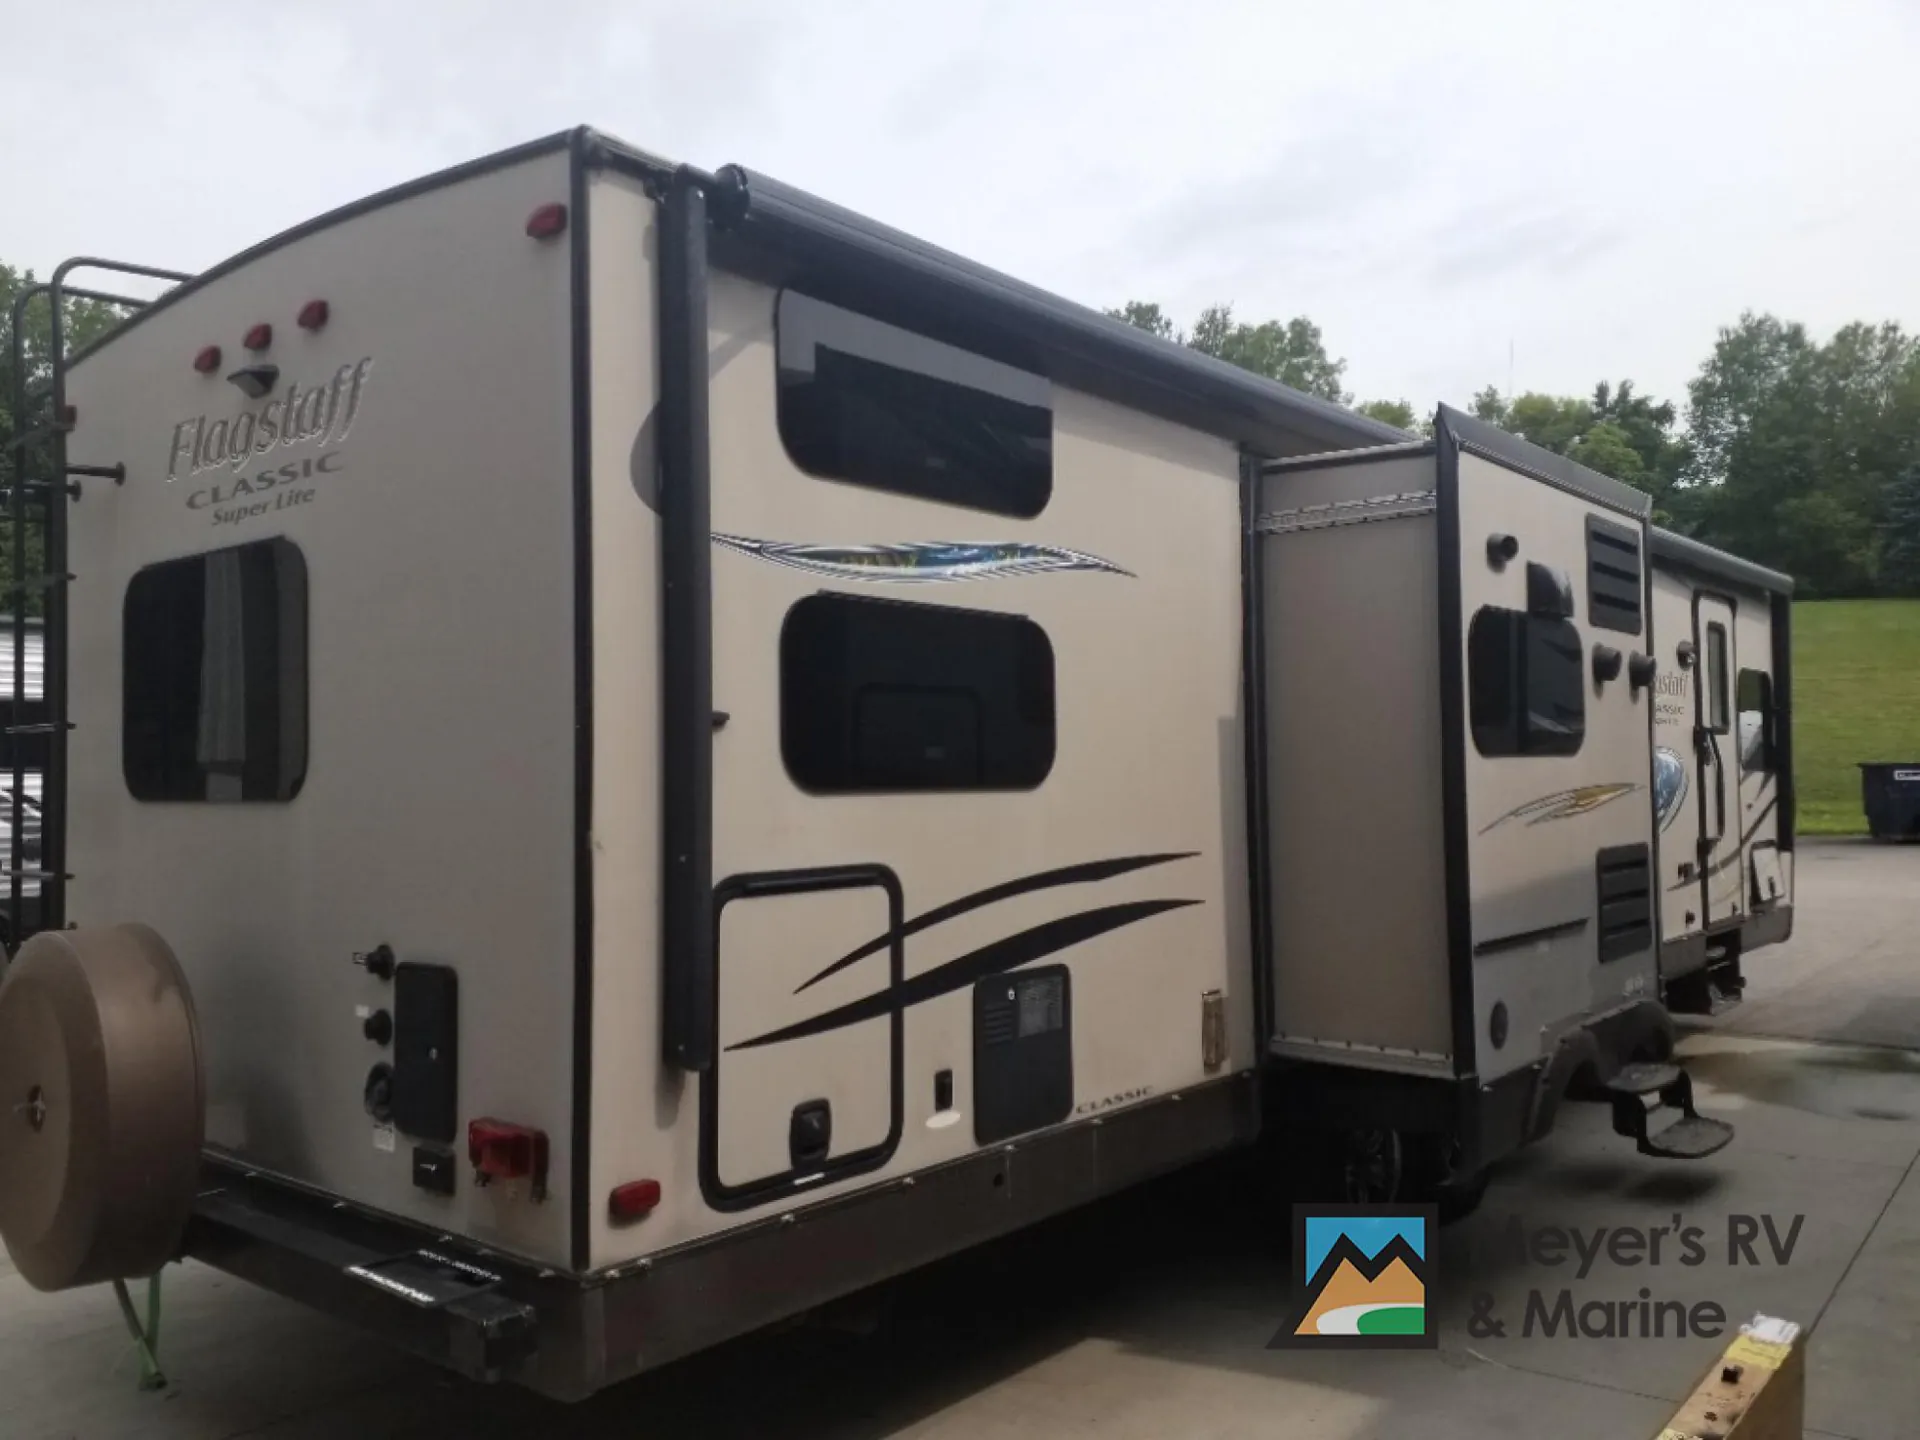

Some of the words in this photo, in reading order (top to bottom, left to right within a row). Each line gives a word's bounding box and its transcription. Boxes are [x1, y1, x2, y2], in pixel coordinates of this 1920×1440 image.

[164, 356, 374, 483] Flagstaff
[186, 452, 344, 511] CLASSIC
[211, 503, 268, 526] Super
[276, 487, 316, 510] Lite
